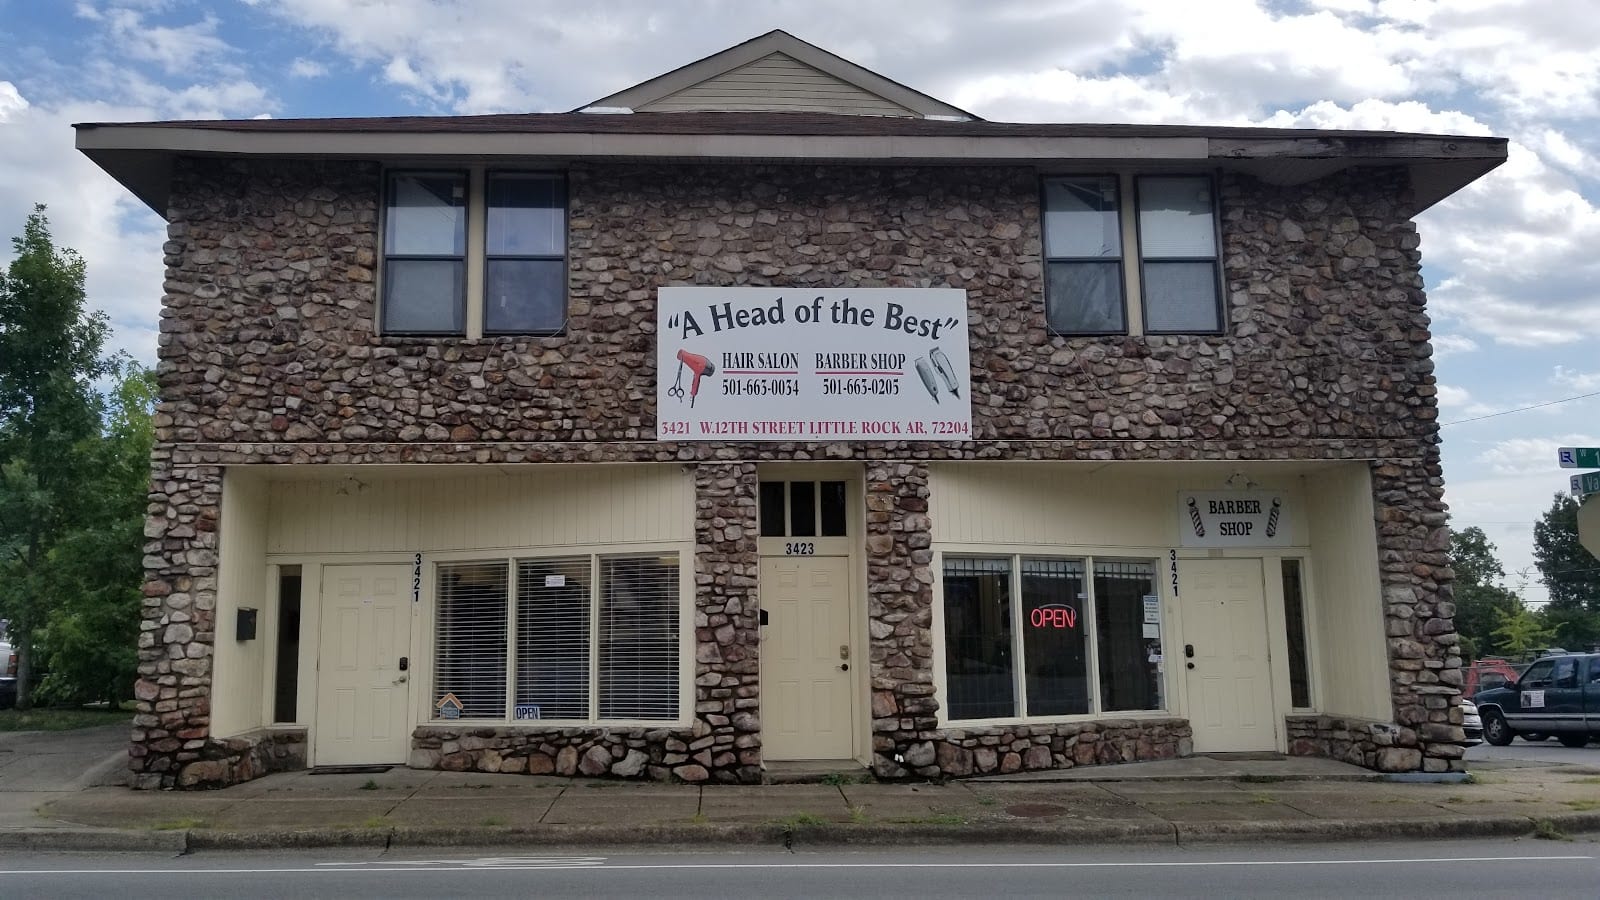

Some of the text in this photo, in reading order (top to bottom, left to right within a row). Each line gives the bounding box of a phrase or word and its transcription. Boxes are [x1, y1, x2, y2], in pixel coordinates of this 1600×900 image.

[708, 297, 786, 332] Head
[794, 296, 825, 323] of
[830, 298, 875, 327] the
[722, 352, 799, 369] HAIR SALON
[815, 352, 906, 370] BARBER SHOP
[722, 379, 799, 396] 501-663-0034
[661, 421, 969, 435] 3421 W.12TH STREET LITTLE ROCK AR, 72204
[1208, 500, 1262, 514] BARBER
[1220, 522, 1253, 536] SHOP
[786, 542, 814, 555] 3423
[1170, 549, 1178, 597] 3421
[1031, 608, 1074, 628] OPEN
[516, 707, 538, 720] OPEN
